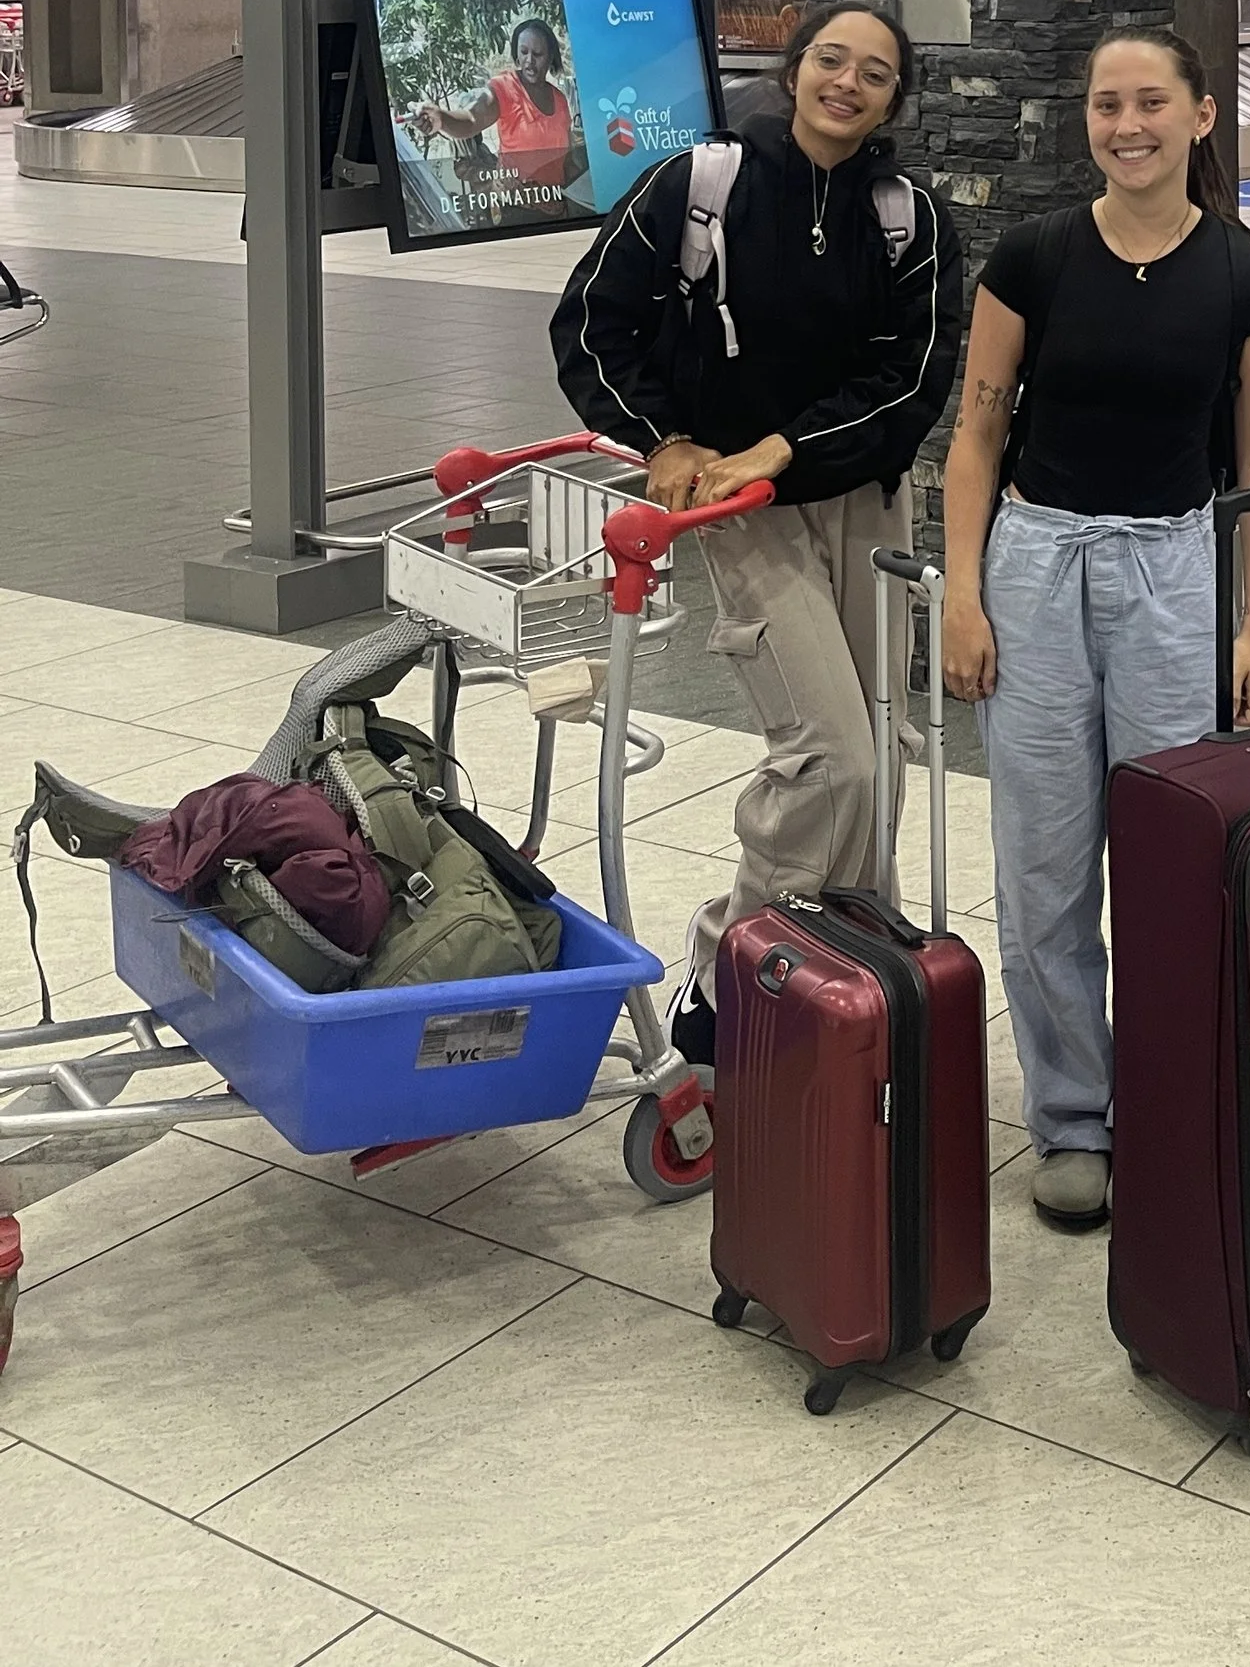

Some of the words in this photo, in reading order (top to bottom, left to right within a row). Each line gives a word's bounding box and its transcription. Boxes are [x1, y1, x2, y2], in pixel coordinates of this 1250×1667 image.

[621, 10, 655, 22] CAWST
[634, 107, 658, 125] Gift
[659, 105, 672, 126] of
[637, 125, 697, 151] Water
[479, 167, 519, 182] CADEAU
[440, 195, 462, 214] DE
[468, 184, 563, 211] FORMATION
